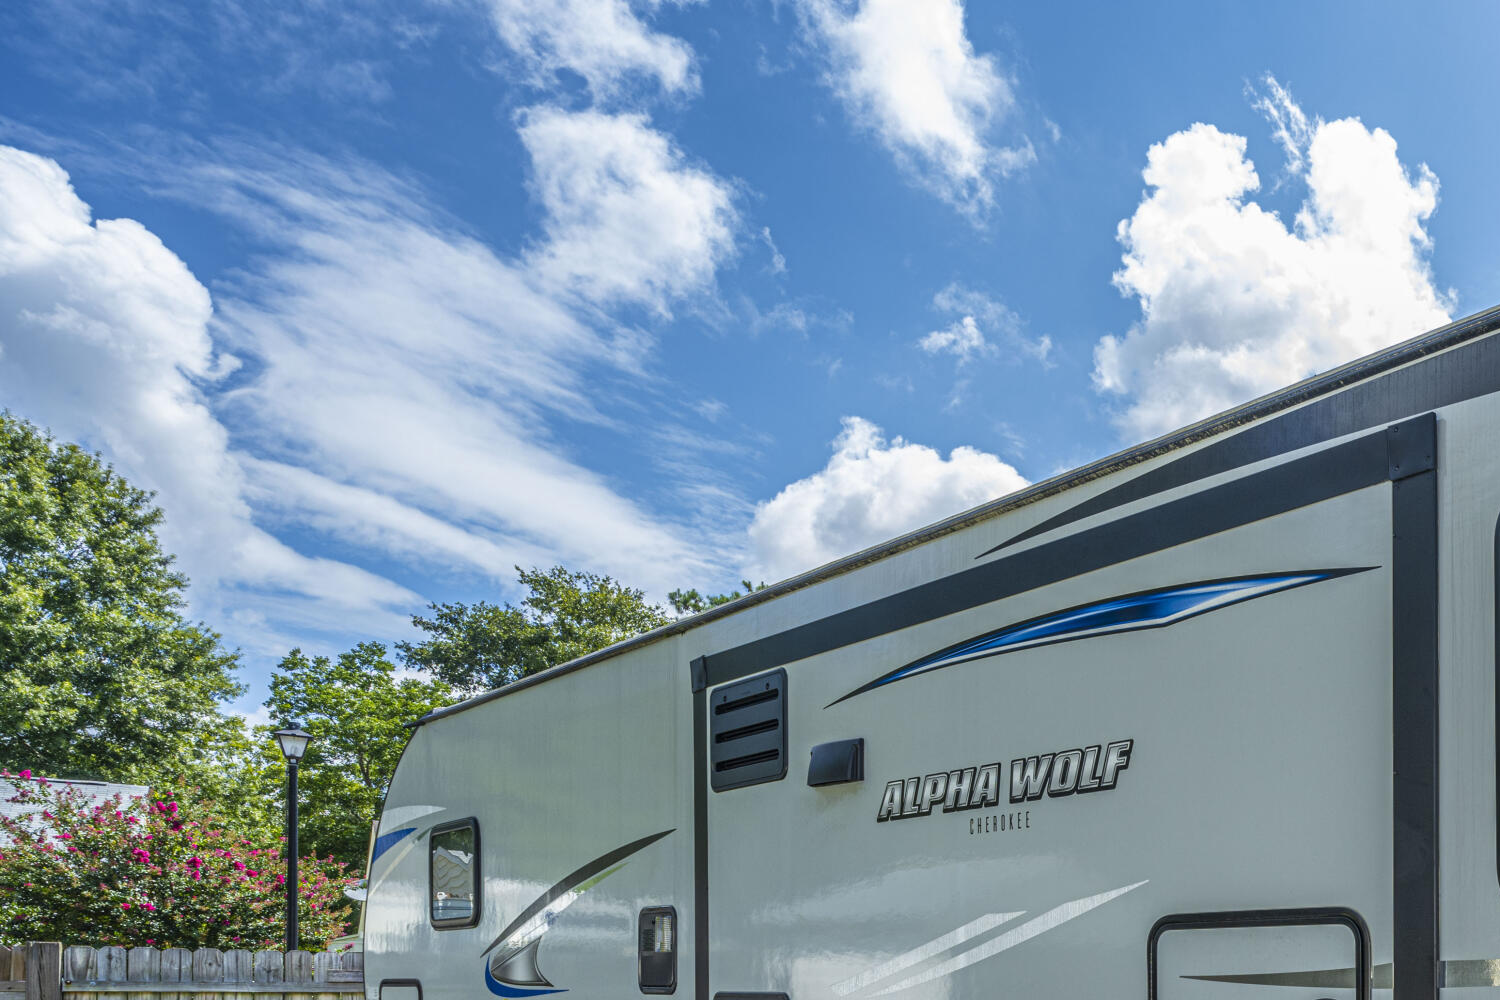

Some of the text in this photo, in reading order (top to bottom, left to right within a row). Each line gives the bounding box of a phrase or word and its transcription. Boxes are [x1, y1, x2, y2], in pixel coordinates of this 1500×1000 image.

[876, 739, 1134, 823] ALPHA WOLF
[969, 811, 1031, 835] CHEROKEE
